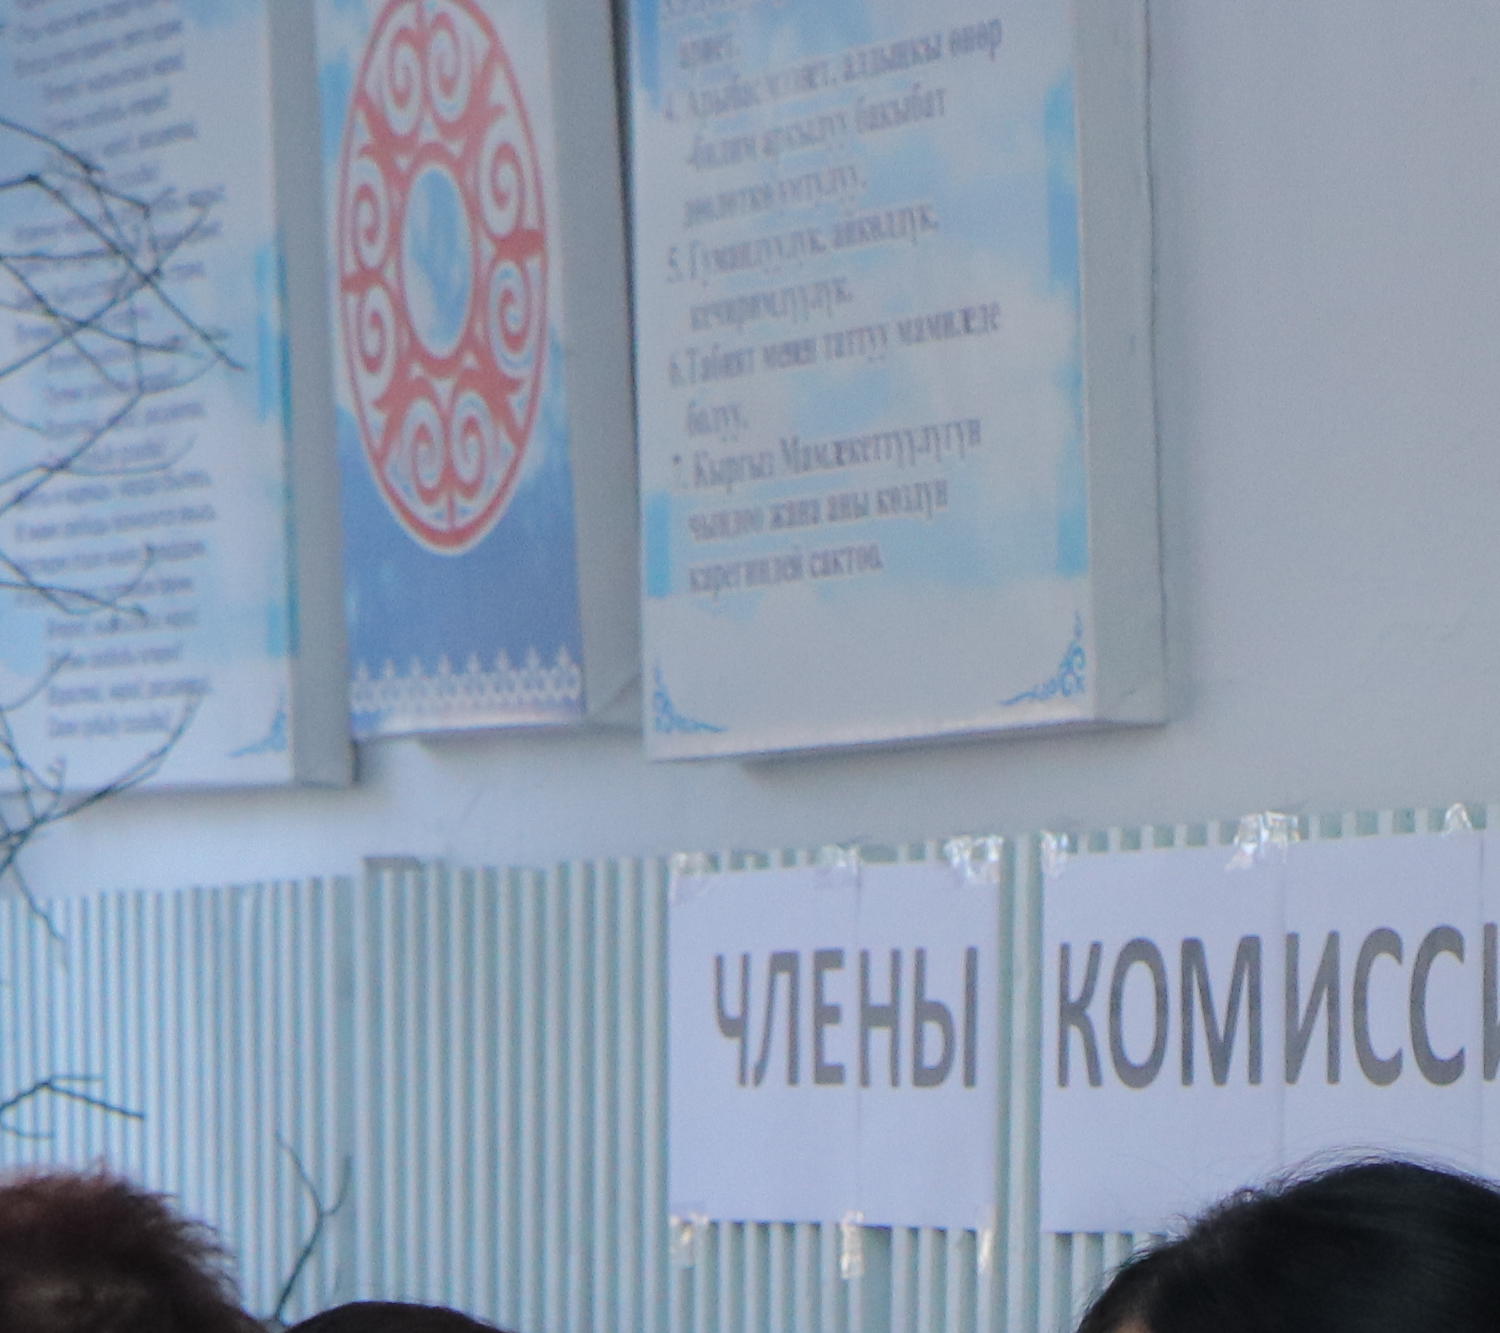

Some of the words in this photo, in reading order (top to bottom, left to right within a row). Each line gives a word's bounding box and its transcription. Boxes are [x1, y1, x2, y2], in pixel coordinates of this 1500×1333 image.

[693, 449, 776, 494] Кыргыз
[768, 497, 822, 531] жана
[825, 489, 872, 522] аны
[712, 945, 979, 1090] ЧЛЕНЫ
